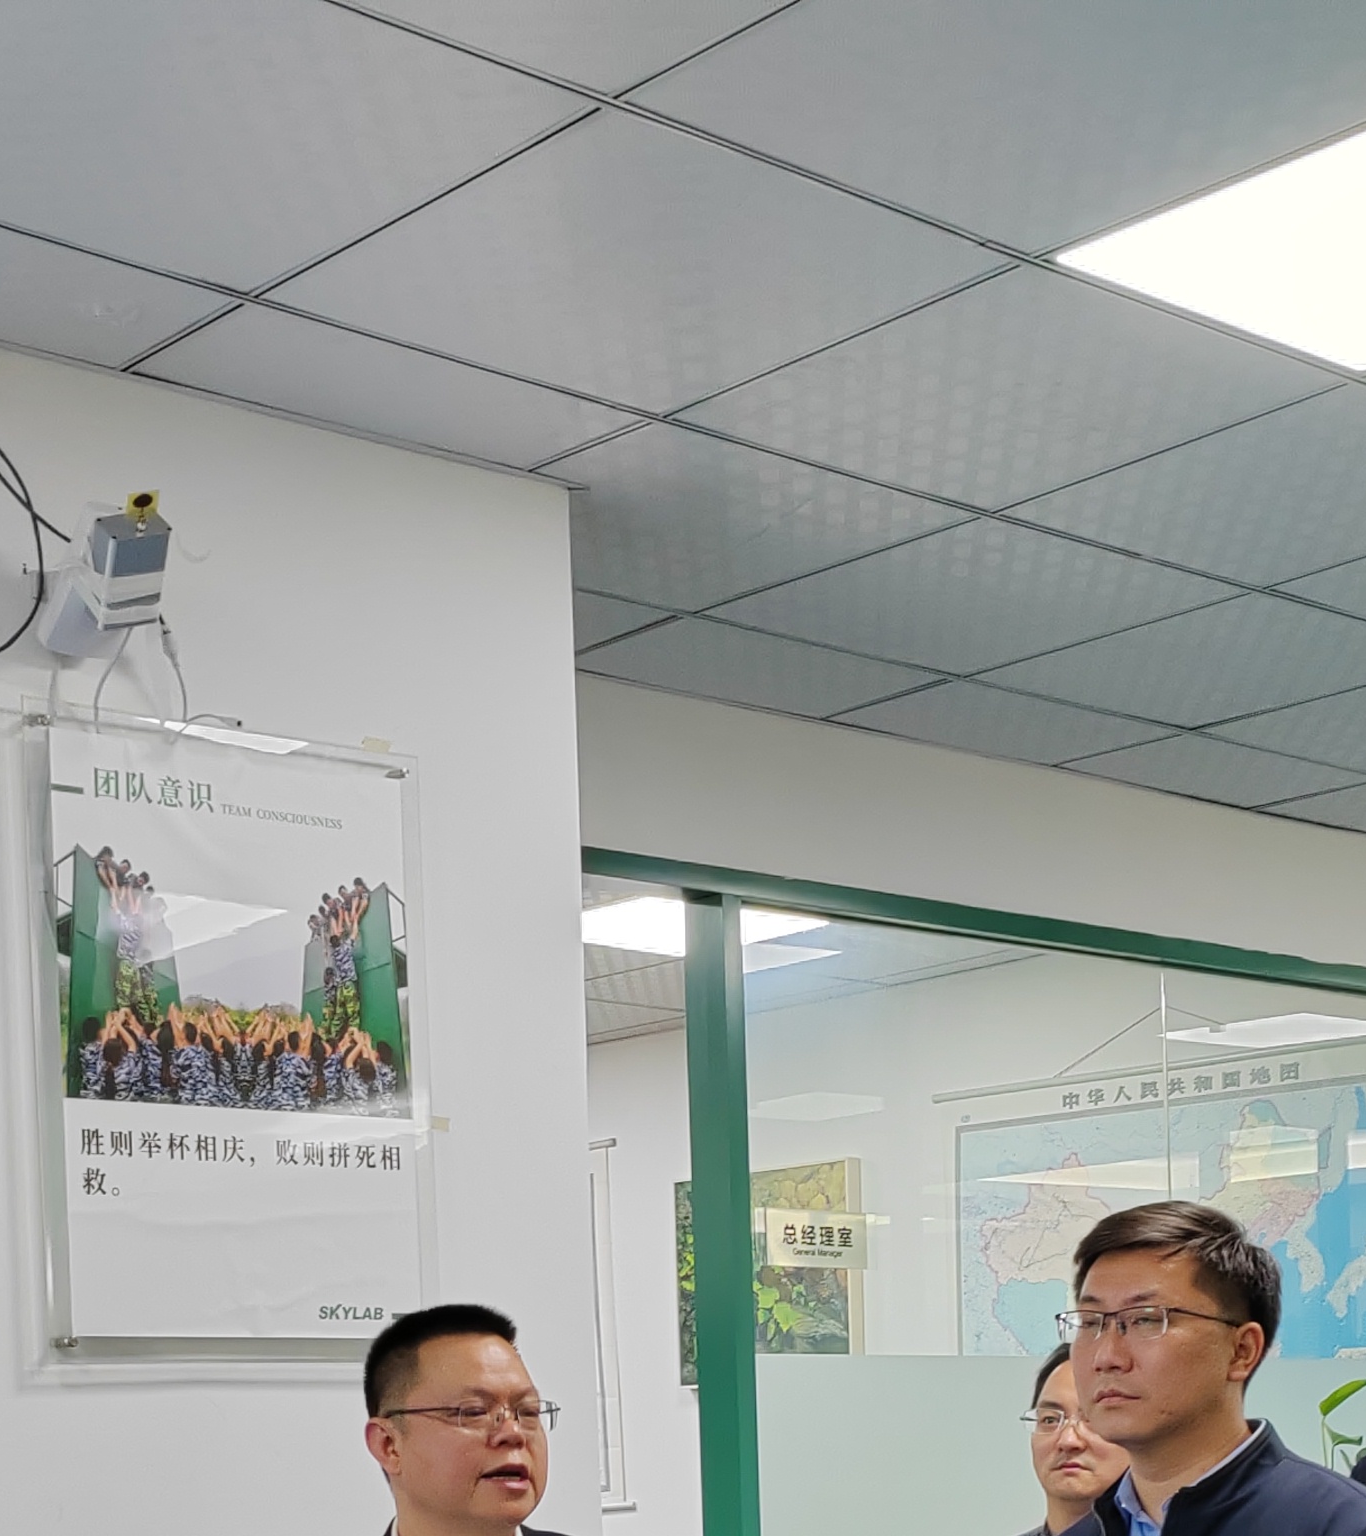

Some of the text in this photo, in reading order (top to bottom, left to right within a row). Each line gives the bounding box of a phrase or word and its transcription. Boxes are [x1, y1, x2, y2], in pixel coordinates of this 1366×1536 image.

[94, 767, 214, 813] 团队意识
[221, 803, 343, 830] TEAM CONSCIOUSNESS
[1062, 1061, 1301, 1110] 中华人民共和国地图
[81, 1128, 401, 1171] 胜则举杯相庆，败则拼死相
[82, 1167, 122, 1197] 救。
[783, 1224, 853, 1248] 总经理室
[792, 1248, 843, 1259] General Manager
[318, 1303, 384, 1320] SKYLAB
